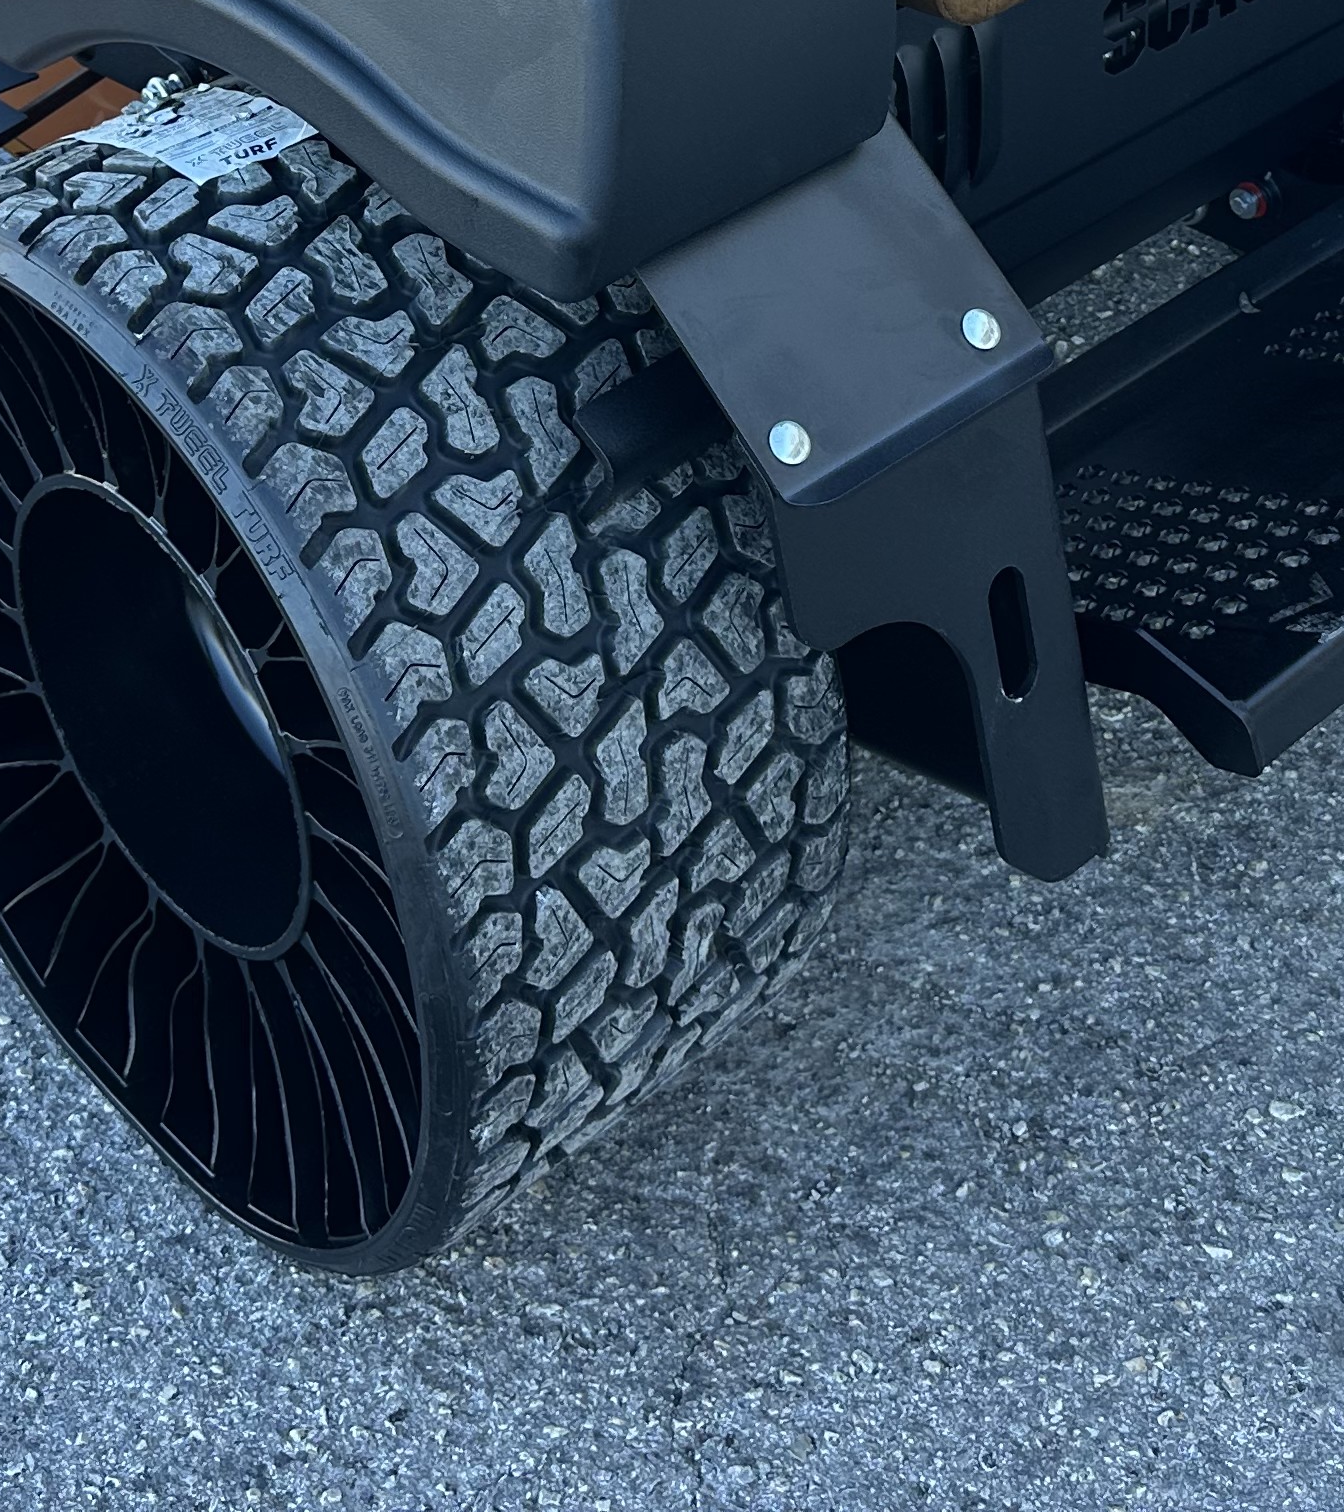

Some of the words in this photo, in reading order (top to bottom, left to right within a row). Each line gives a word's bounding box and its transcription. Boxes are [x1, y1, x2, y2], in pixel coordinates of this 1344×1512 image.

[211, 122, 288, 156] TWEEL
[218, 137, 279, 167] TURF
[155, 388, 228, 496] TWEEL
[231, 490, 294, 581] TURF
